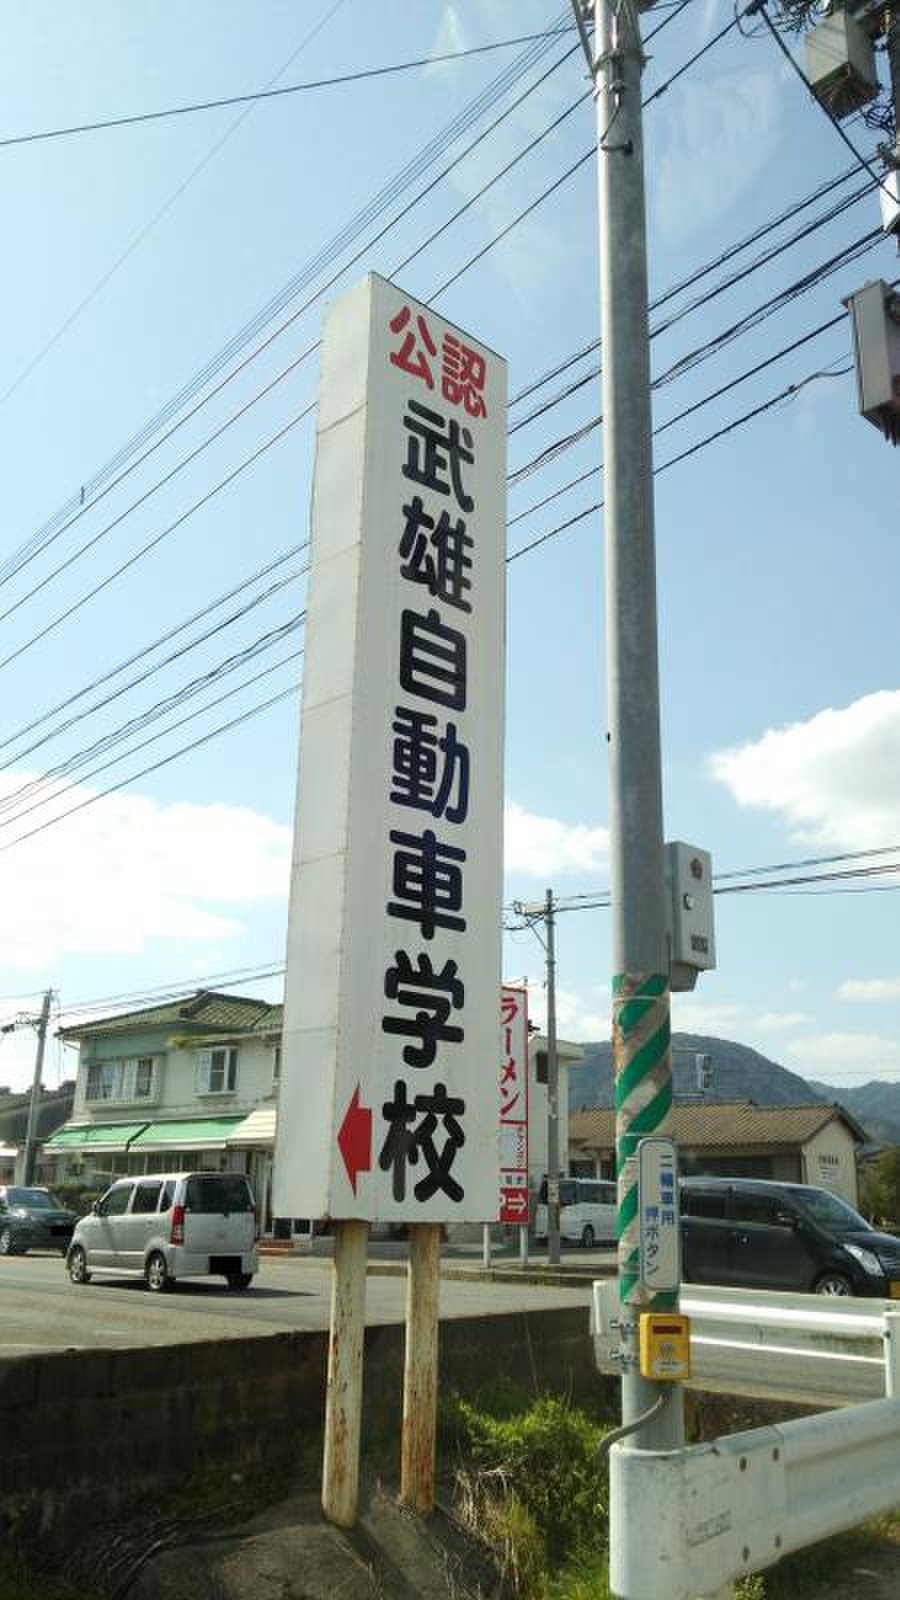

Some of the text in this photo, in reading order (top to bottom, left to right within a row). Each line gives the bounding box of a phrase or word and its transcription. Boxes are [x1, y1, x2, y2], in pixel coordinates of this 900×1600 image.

[389, 304, 487, 418] 公認
[378, 400, 475, 1202] 武雄自動車学校
[500, 998, 519, 1117] ラーメン
